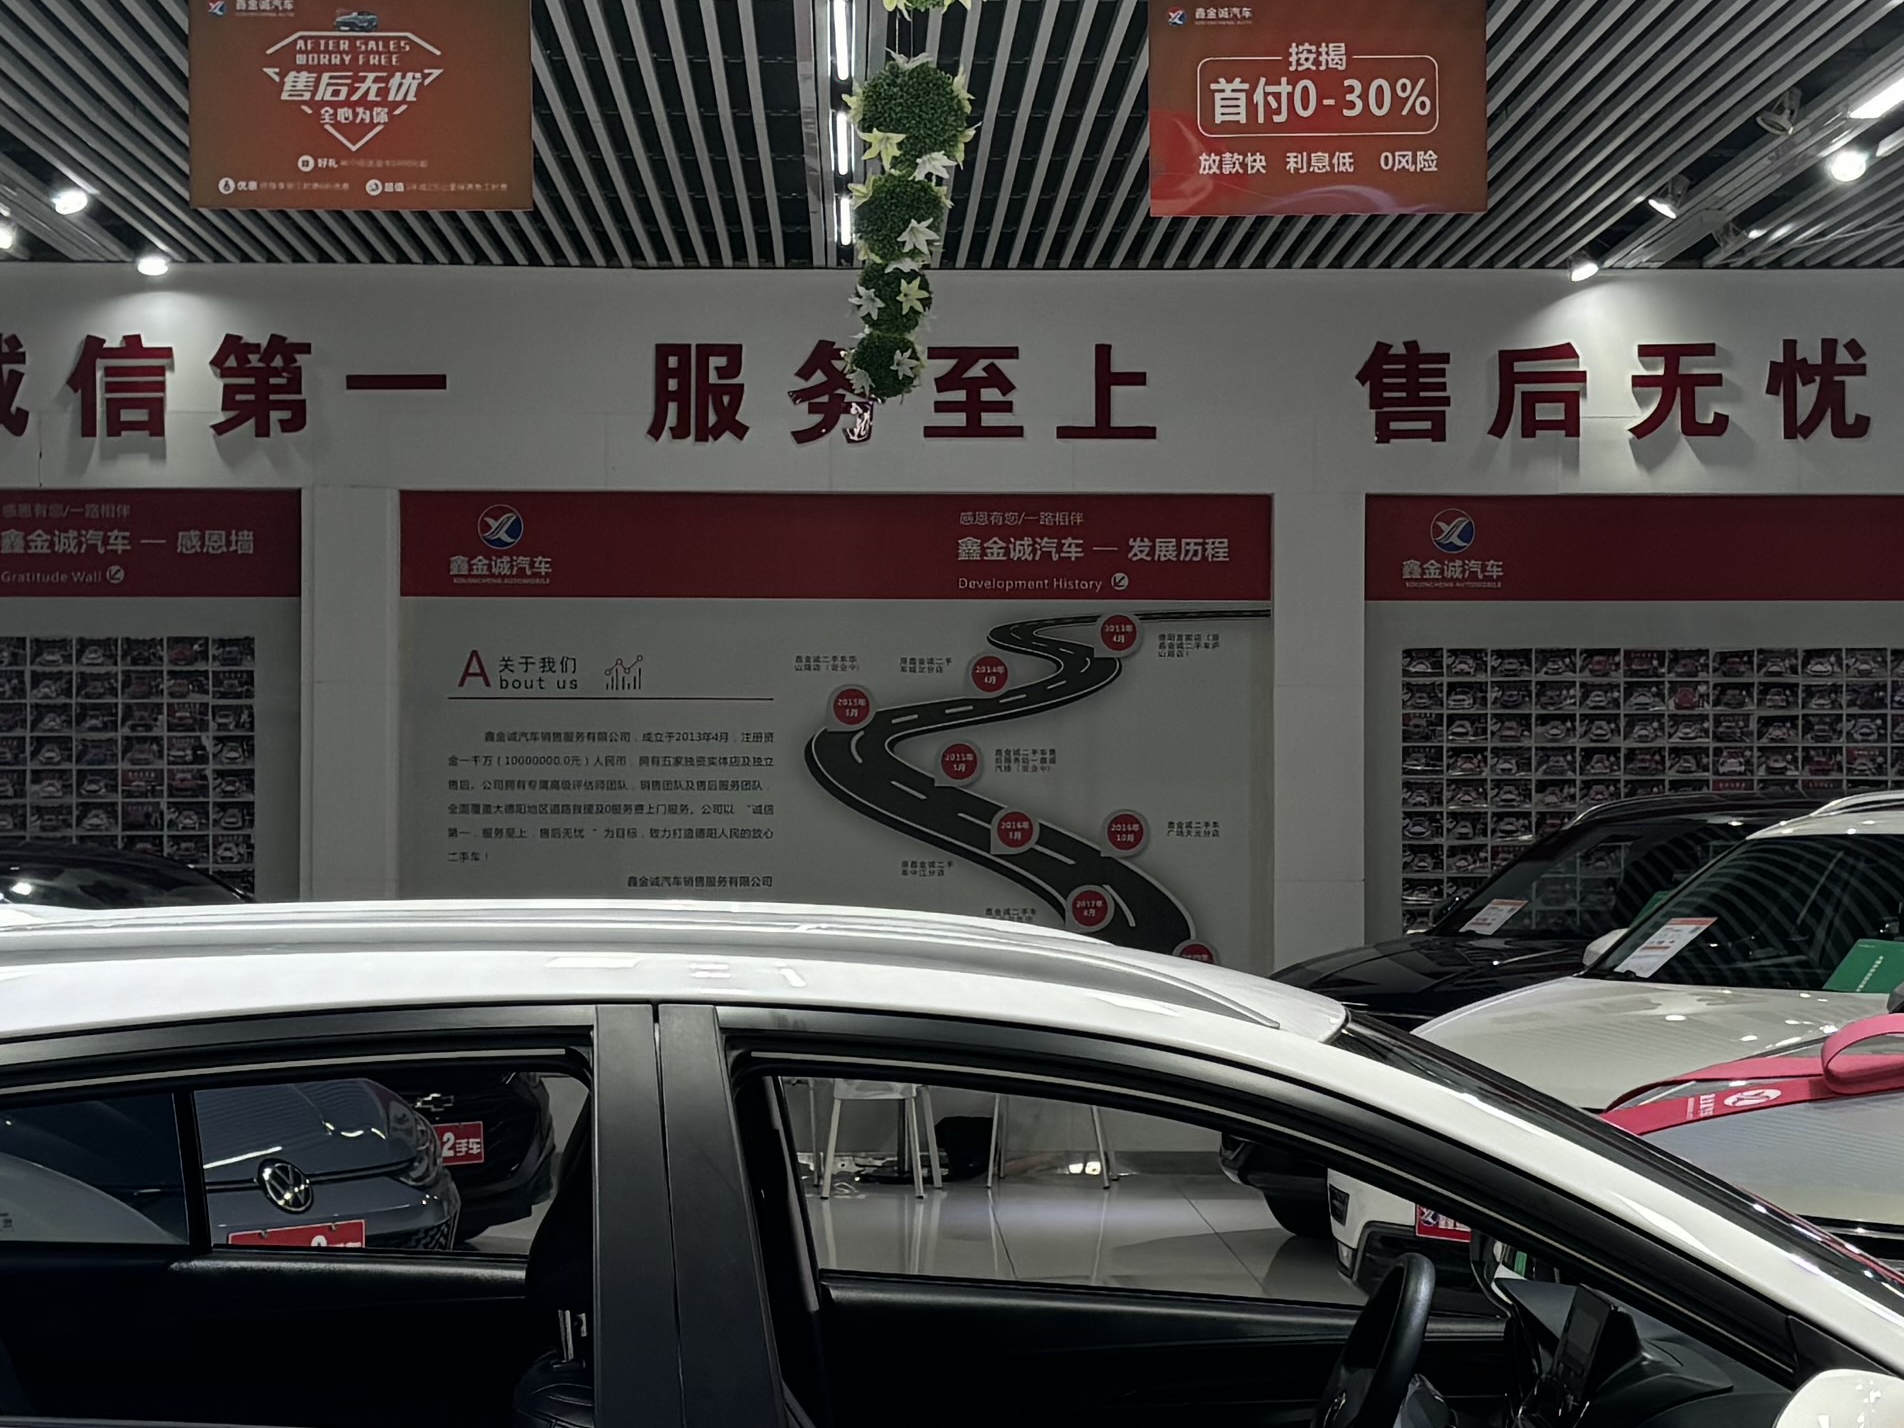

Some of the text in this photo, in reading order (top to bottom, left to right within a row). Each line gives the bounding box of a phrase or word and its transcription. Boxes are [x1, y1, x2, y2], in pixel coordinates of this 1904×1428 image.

[296, 39, 411, 52] AFTER SALES
[358, 53, 401, 66] FREE
[1288, 42, 1348, 71] 按揭
[280, 71, 424, 102] 售后无忧
[1209, 77, 1432, 124] 首付0-30%
[319, 106, 390, 124] 全心为你
[1199, 150, 1439, 175] 放款快 利息低 0风险
[646, 338, 1158, 445] 服务至上
[1352, 338, 1874, 446] 售后无忧
[0, 529, 132, 555] 鑫金诚汽车
[176, 529, 255, 555] 感恩墙
[957, 536, 1085, 562] 鑫金诚汽车
[1127, 537, 1231, 562] 发展历程
[449, 555, 553, 576] 鑫金诚汽车
[1402, 559, 1504, 579] 鑫金诚汽车
[0, 571, 102, 584] Gratitude Wall
[957, 577, 1103, 593] Development History
[498, 655, 577, 674] 关于我们
[556, 679, 578, 691] us
[441, 1131, 482, 1157] 2手车
